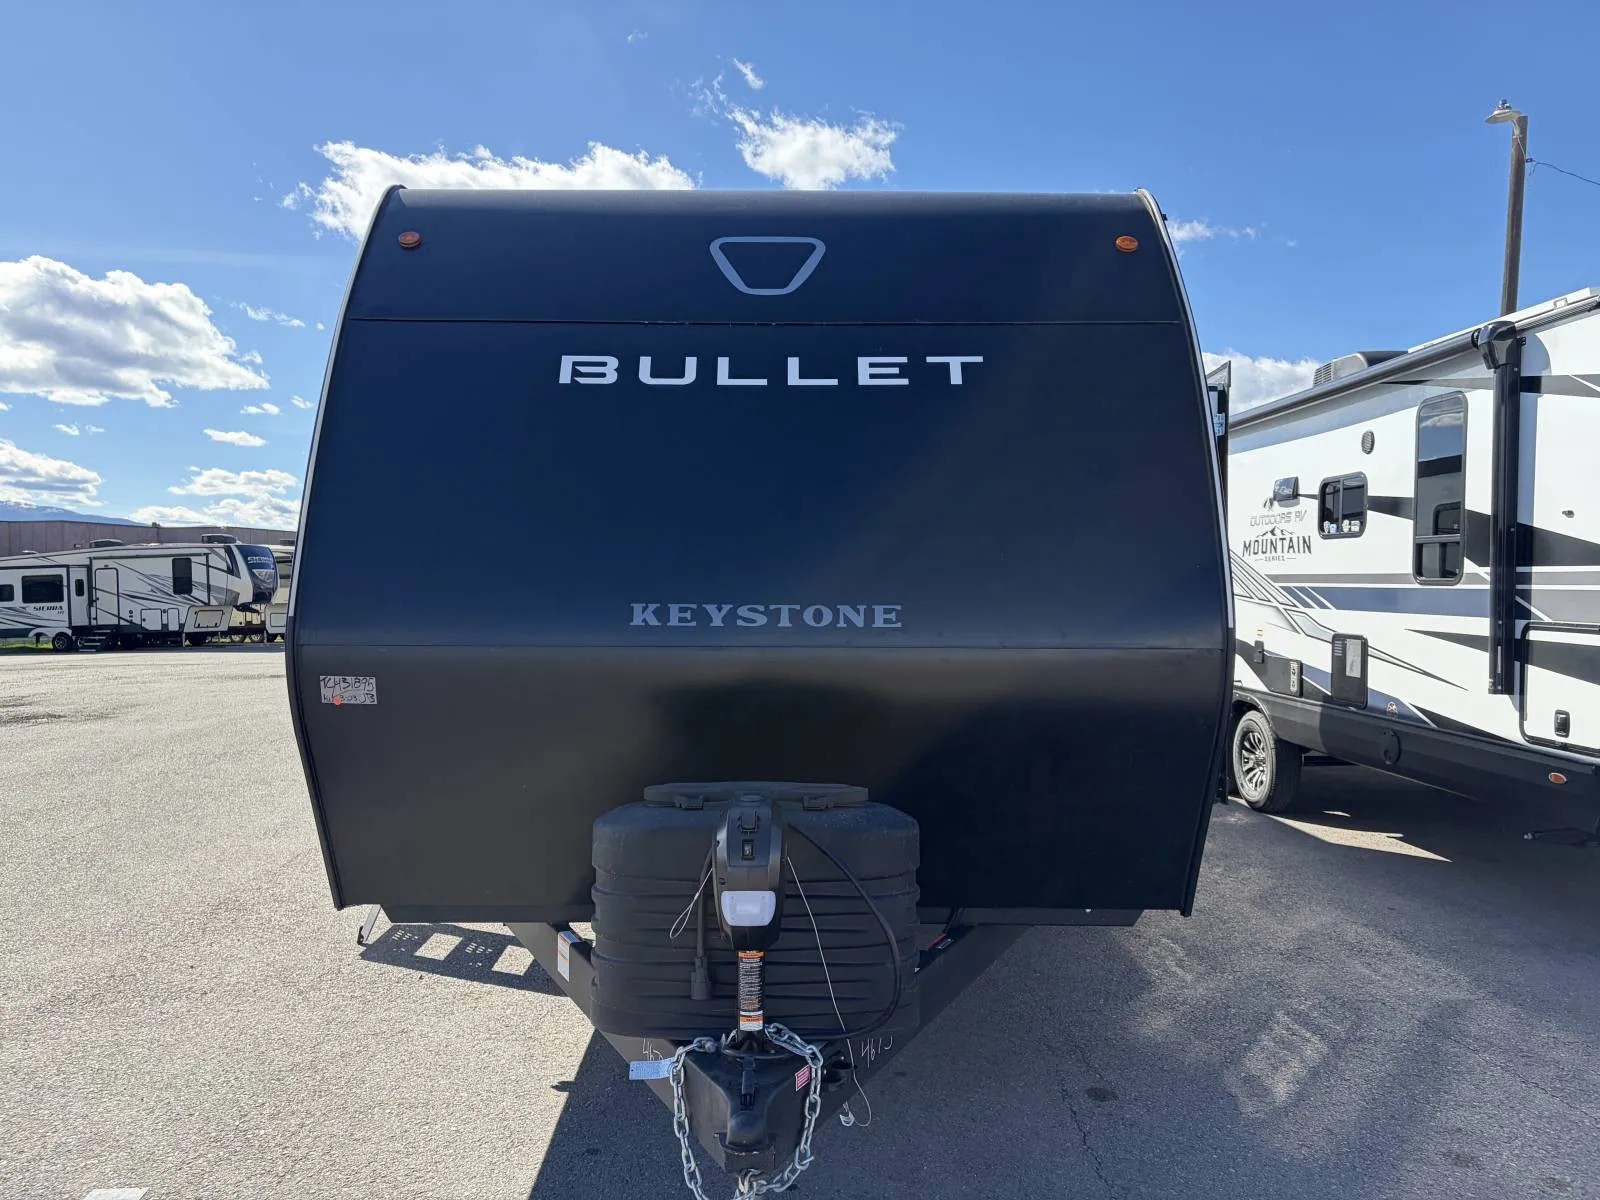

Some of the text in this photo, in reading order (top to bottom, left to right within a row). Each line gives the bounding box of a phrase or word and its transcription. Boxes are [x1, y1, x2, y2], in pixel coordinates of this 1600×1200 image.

[558, 355, 984, 386] BULLET
[1249, 511, 1292, 527] OUTDOORS
[1241, 535, 1312, 557] MOUNTAIN
[629, 603, 903, 628] KEYSTONE
